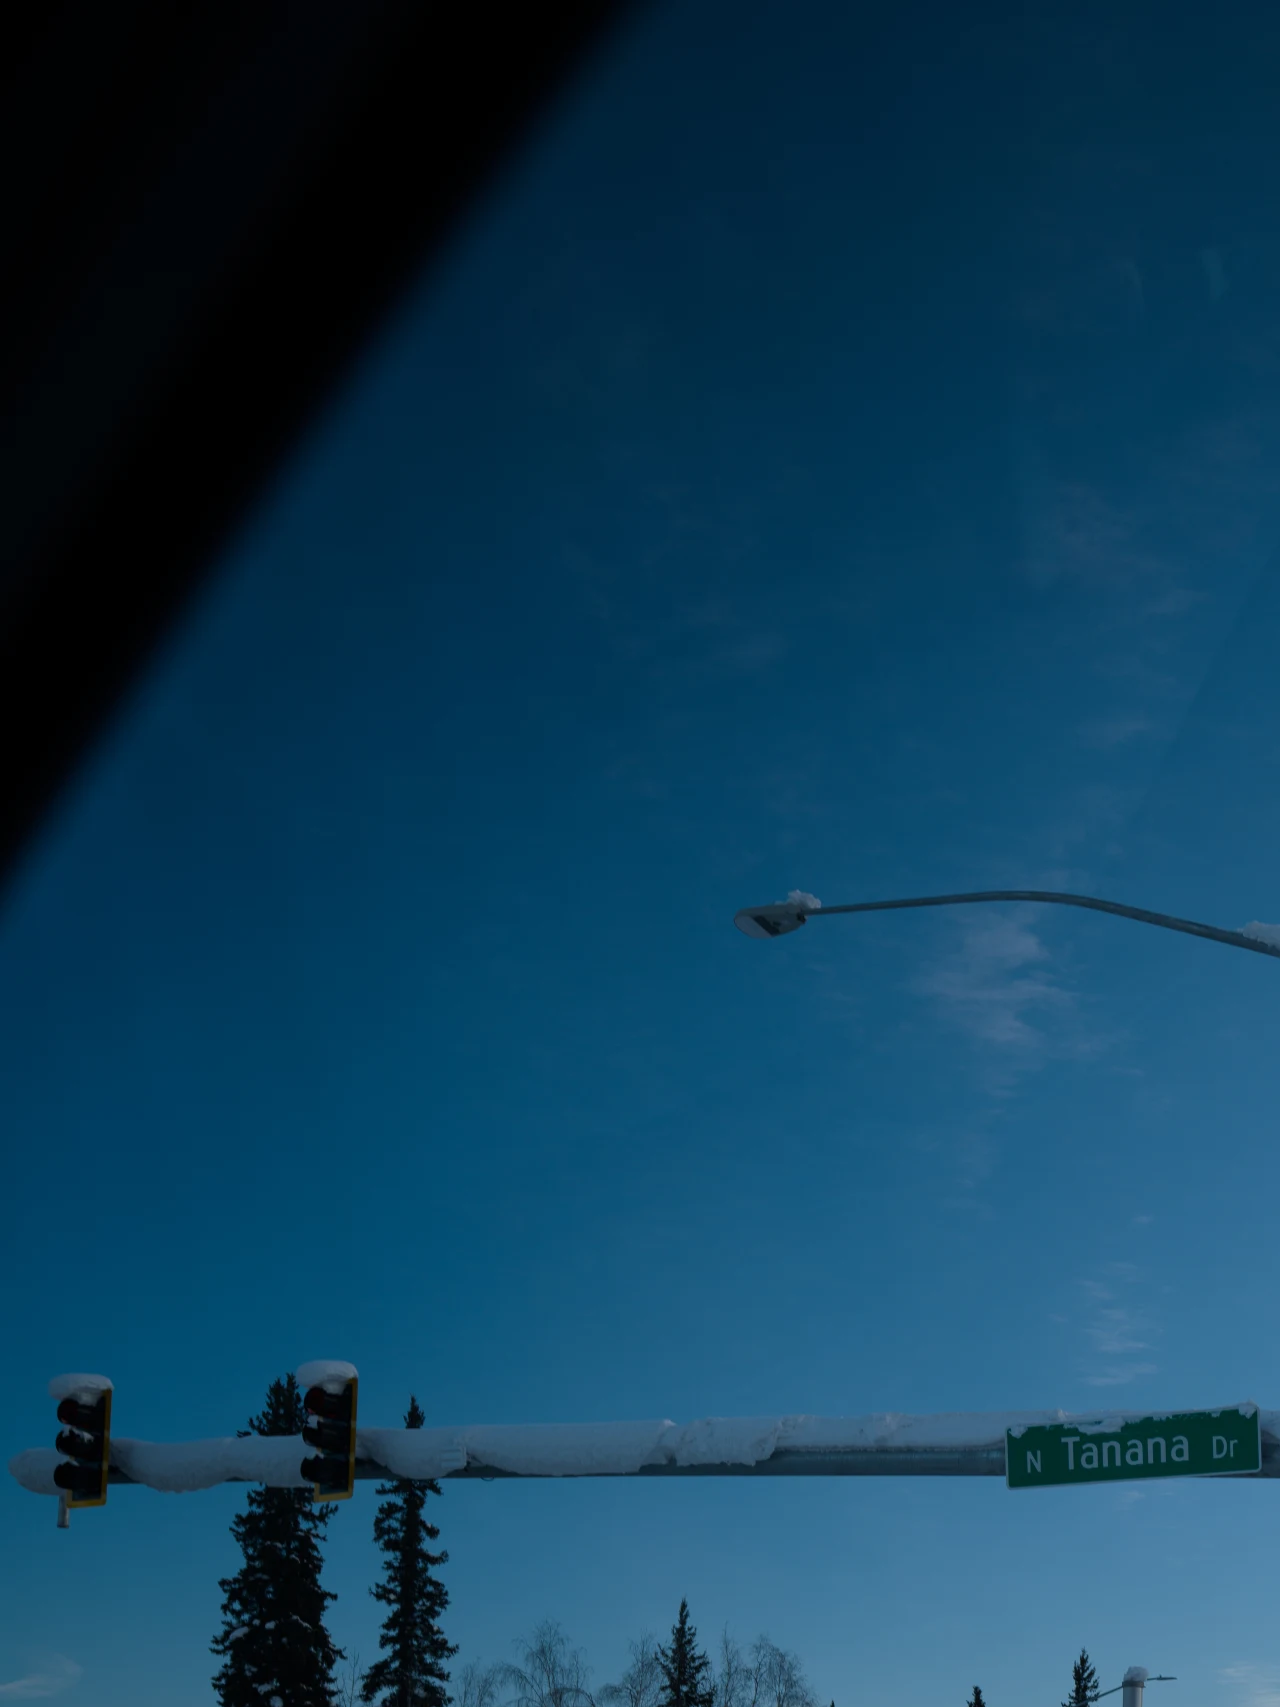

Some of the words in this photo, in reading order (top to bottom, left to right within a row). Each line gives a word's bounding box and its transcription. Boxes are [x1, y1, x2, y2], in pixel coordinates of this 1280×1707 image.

[1026, 1449, 1042, 1474] N
[1061, 1435, 1190, 1471] Tanana
[1212, 1435, 1239, 1459] Dr
